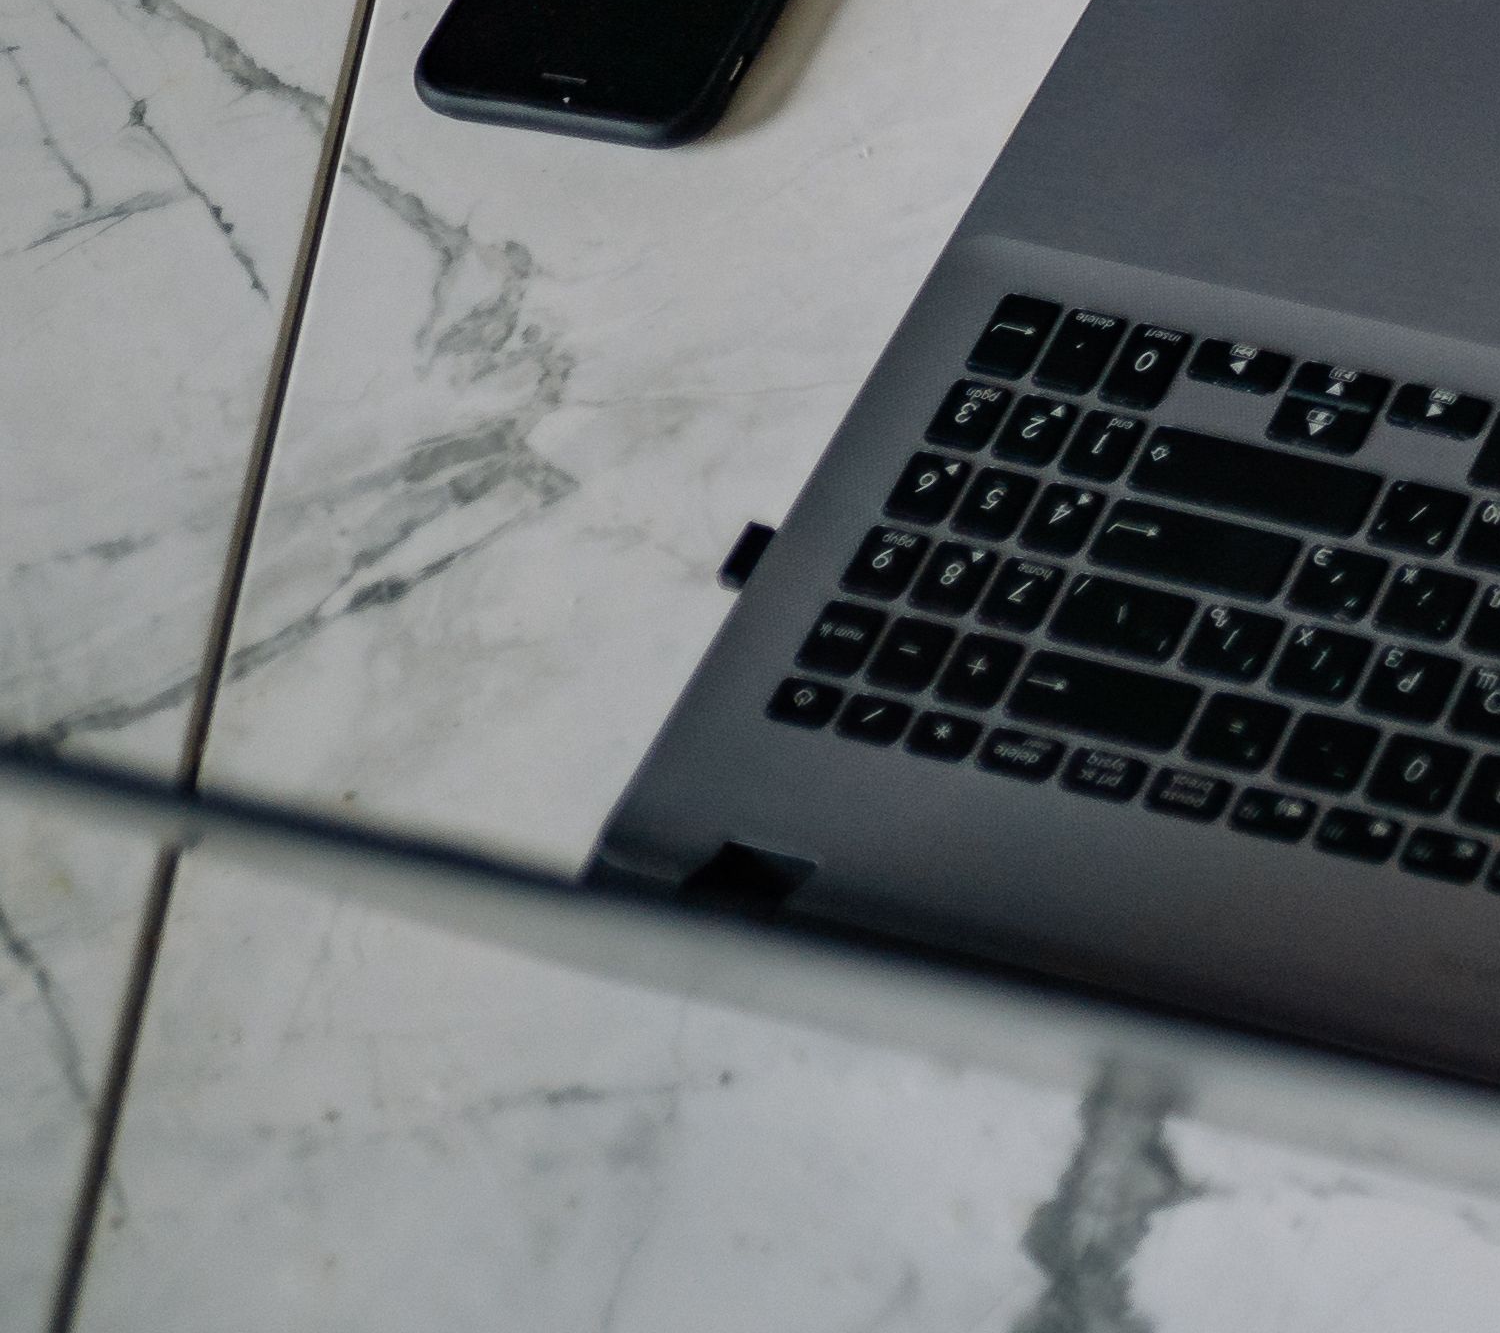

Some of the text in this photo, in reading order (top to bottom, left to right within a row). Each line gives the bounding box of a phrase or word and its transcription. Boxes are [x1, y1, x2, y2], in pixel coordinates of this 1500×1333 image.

[1076, 313, 1116, 329] delete
[1144, 327, 1182, 343] insert
[964, 387, 1002, 405] pgdn
[954, 399, 980, 423] 3
[1022, 415, 1046, 439] 2
[1092, 433, 1110, 455] 1
[916, 471, 938, 493] 6
[980, 487, 1004, 509] 5
[1048, 503, 1072, 523] 4
[882, 531, 916, 547] pgup
[872, 547, 894, 569] 9
[940, 561, 966, 585] 8
[1018, 561, 1054, 581] home
[1008, 581, 1032, 603] 7
[834, 627, 864, 641] num
[1398, 671, 1422, 693] P
[994, 743, 1040, 765] delete
